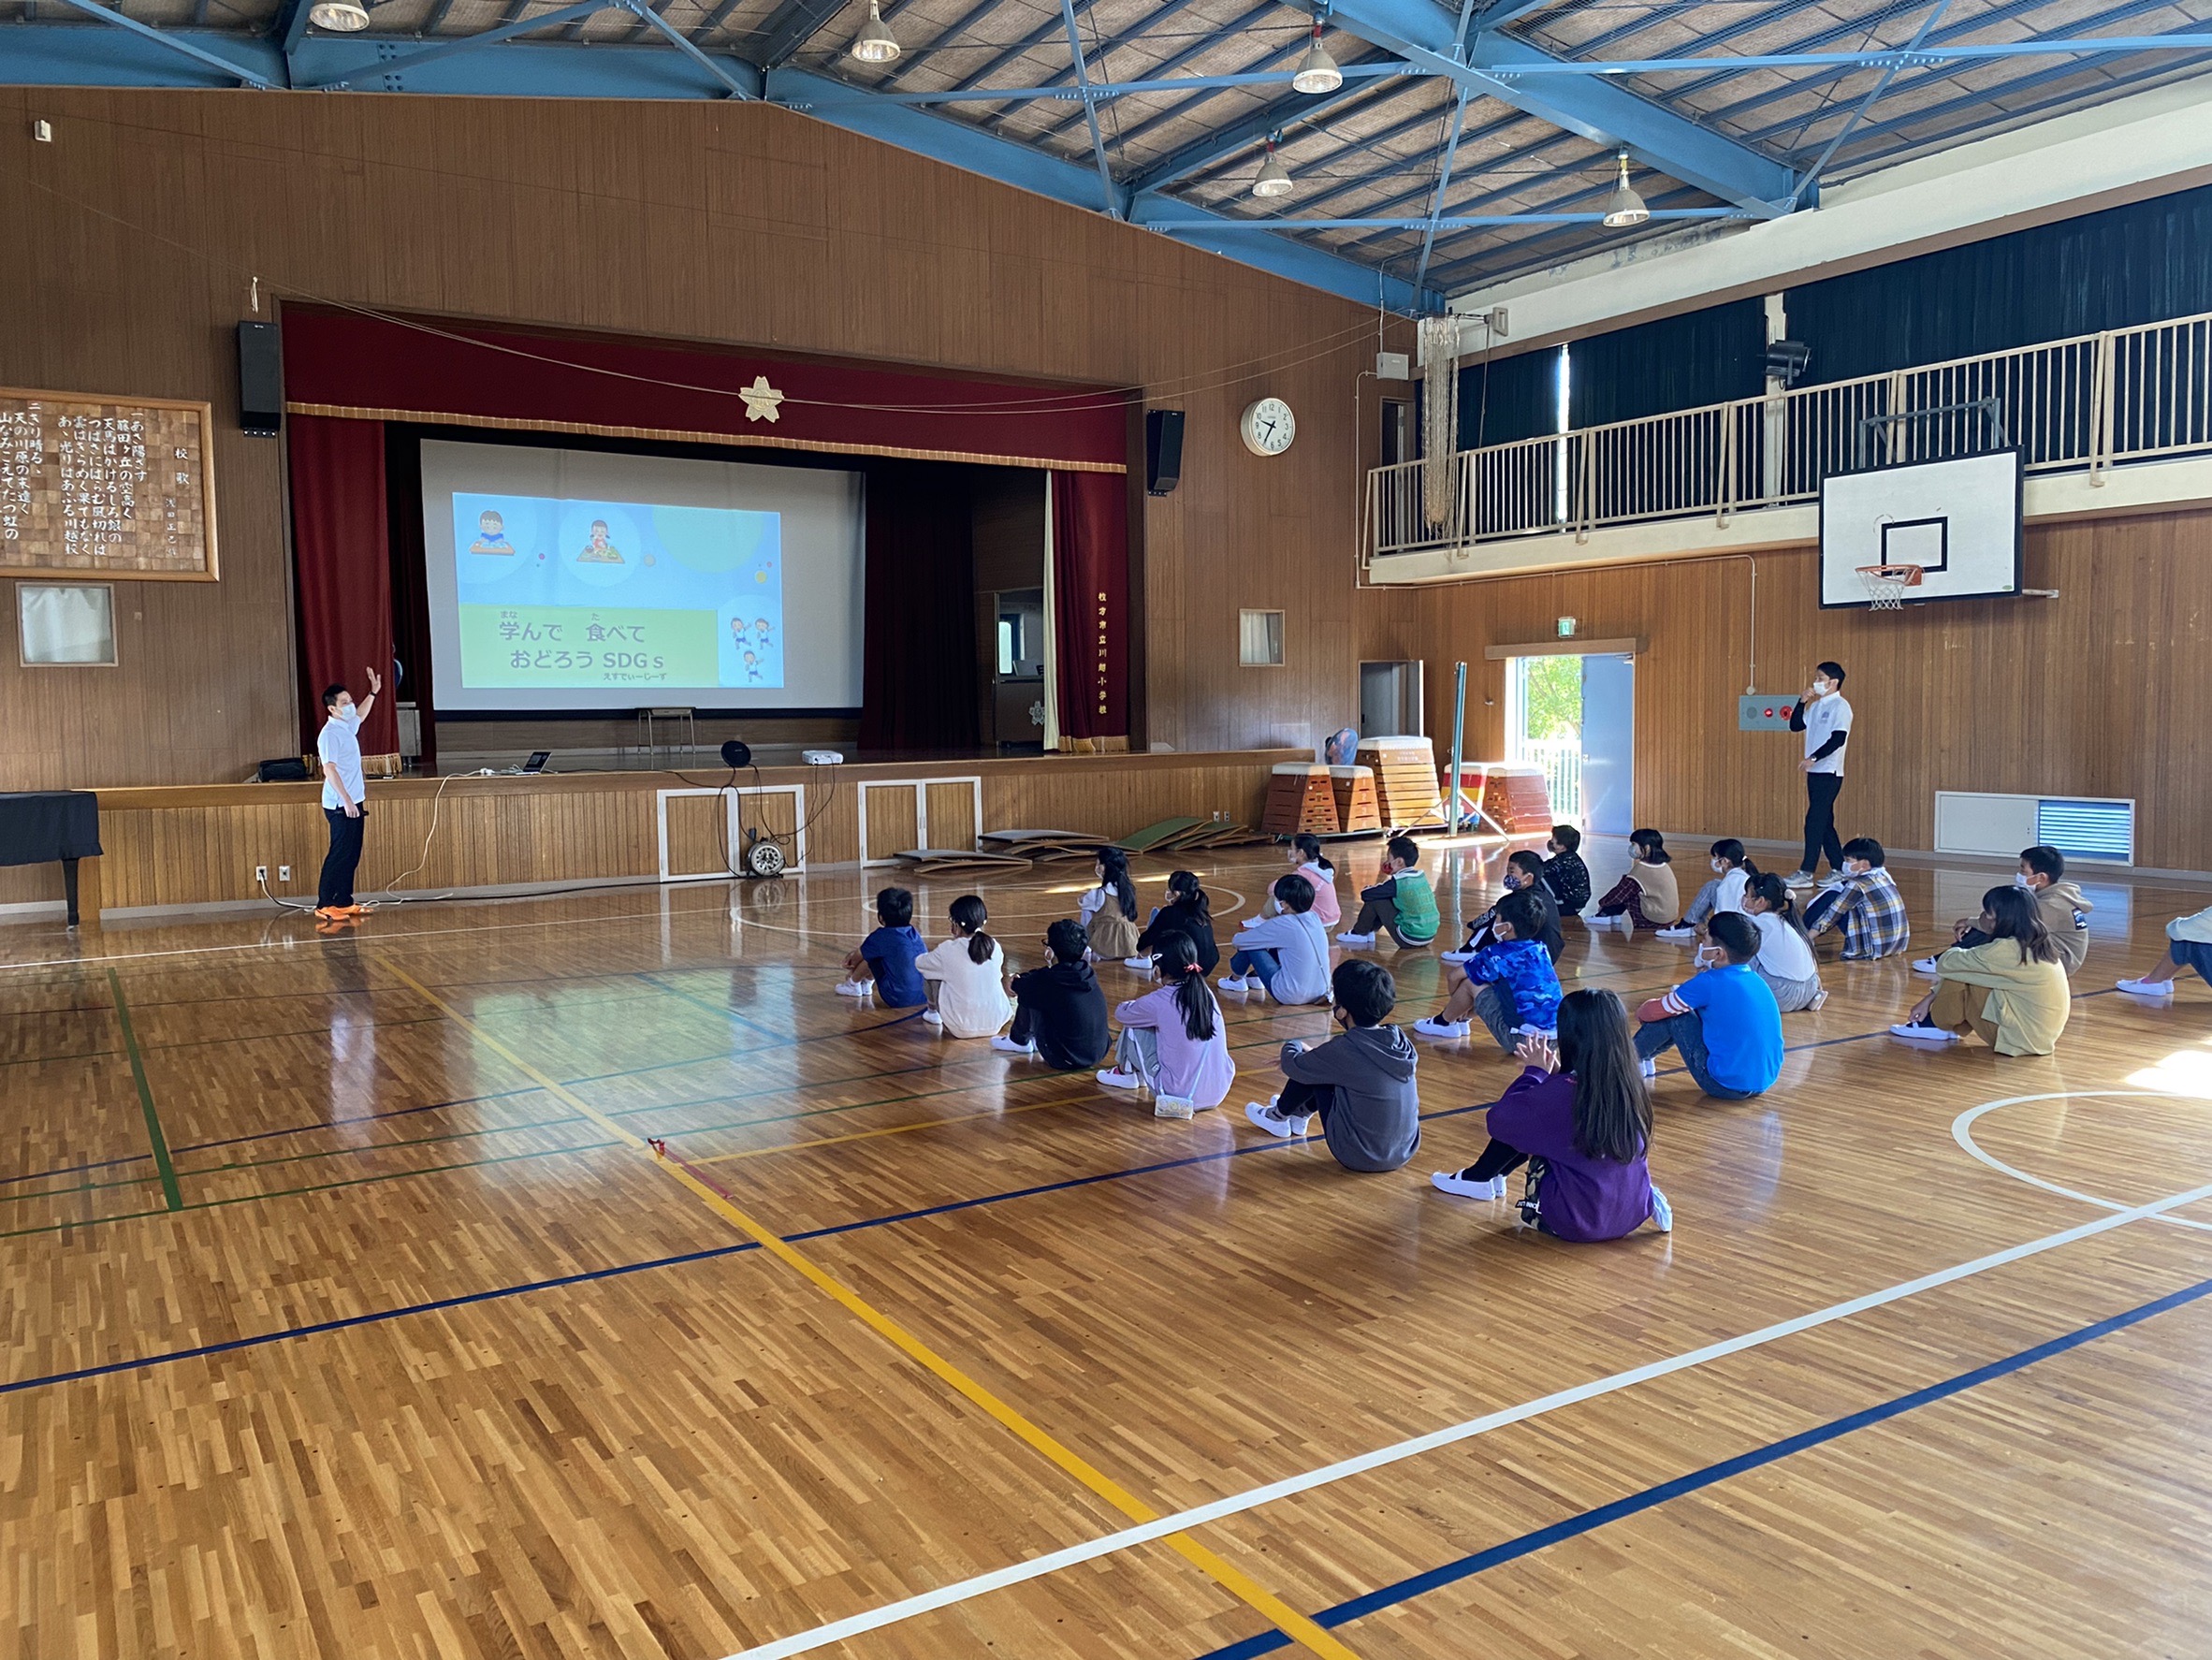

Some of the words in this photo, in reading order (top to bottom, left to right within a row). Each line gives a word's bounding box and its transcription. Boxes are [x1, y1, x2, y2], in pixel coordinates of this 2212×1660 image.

[500, 611, 518, 619] まな
[590, 612, 601, 621] た
[499, 621, 563, 643] 学んで
[586, 623, 646, 644] 食べて
[510, 649, 594, 670] おどろう
